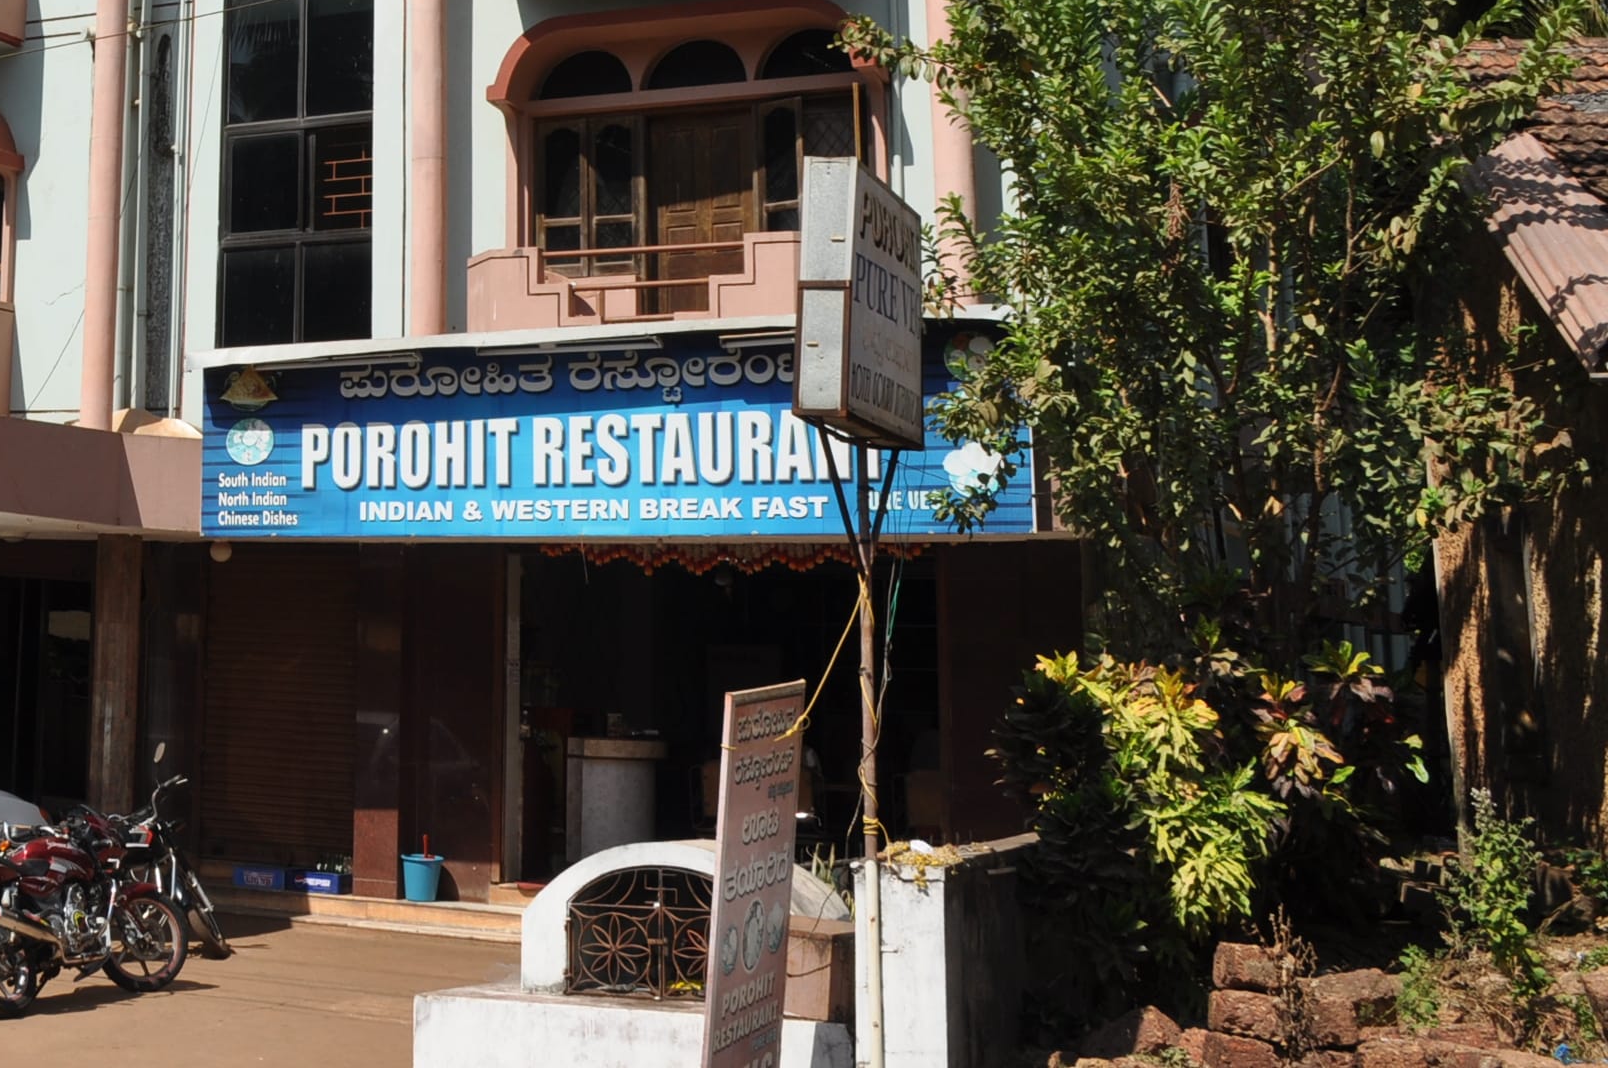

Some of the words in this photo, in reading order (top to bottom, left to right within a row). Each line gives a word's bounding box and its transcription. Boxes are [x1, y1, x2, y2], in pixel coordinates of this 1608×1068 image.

[854, 252, 899, 324] PURE
[339, 355, 554, 398] ಪುರೋಹಿತ
[301, 418, 519, 491] POROHIT
[218, 472, 248, 487] South
[251, 471, 286, 486] Indian
[218, 491, 249, 506] North
[252, 491, 287, 506] Indian
[218, 510, 260, 526] Chinese
[262, 510, 298, 526] Dishes
[360, 501, 454, 522] INDIAN
[462, 500, 484, 522] &
[491, 499, 630, 522] WESTERN
[639, 497, 743, 520] BREAK
[752, 496, 829, 519] FAST
[722, 972, 776, 1020] POROHIT
[713, 999, 779, 1054] RESTAURANT
